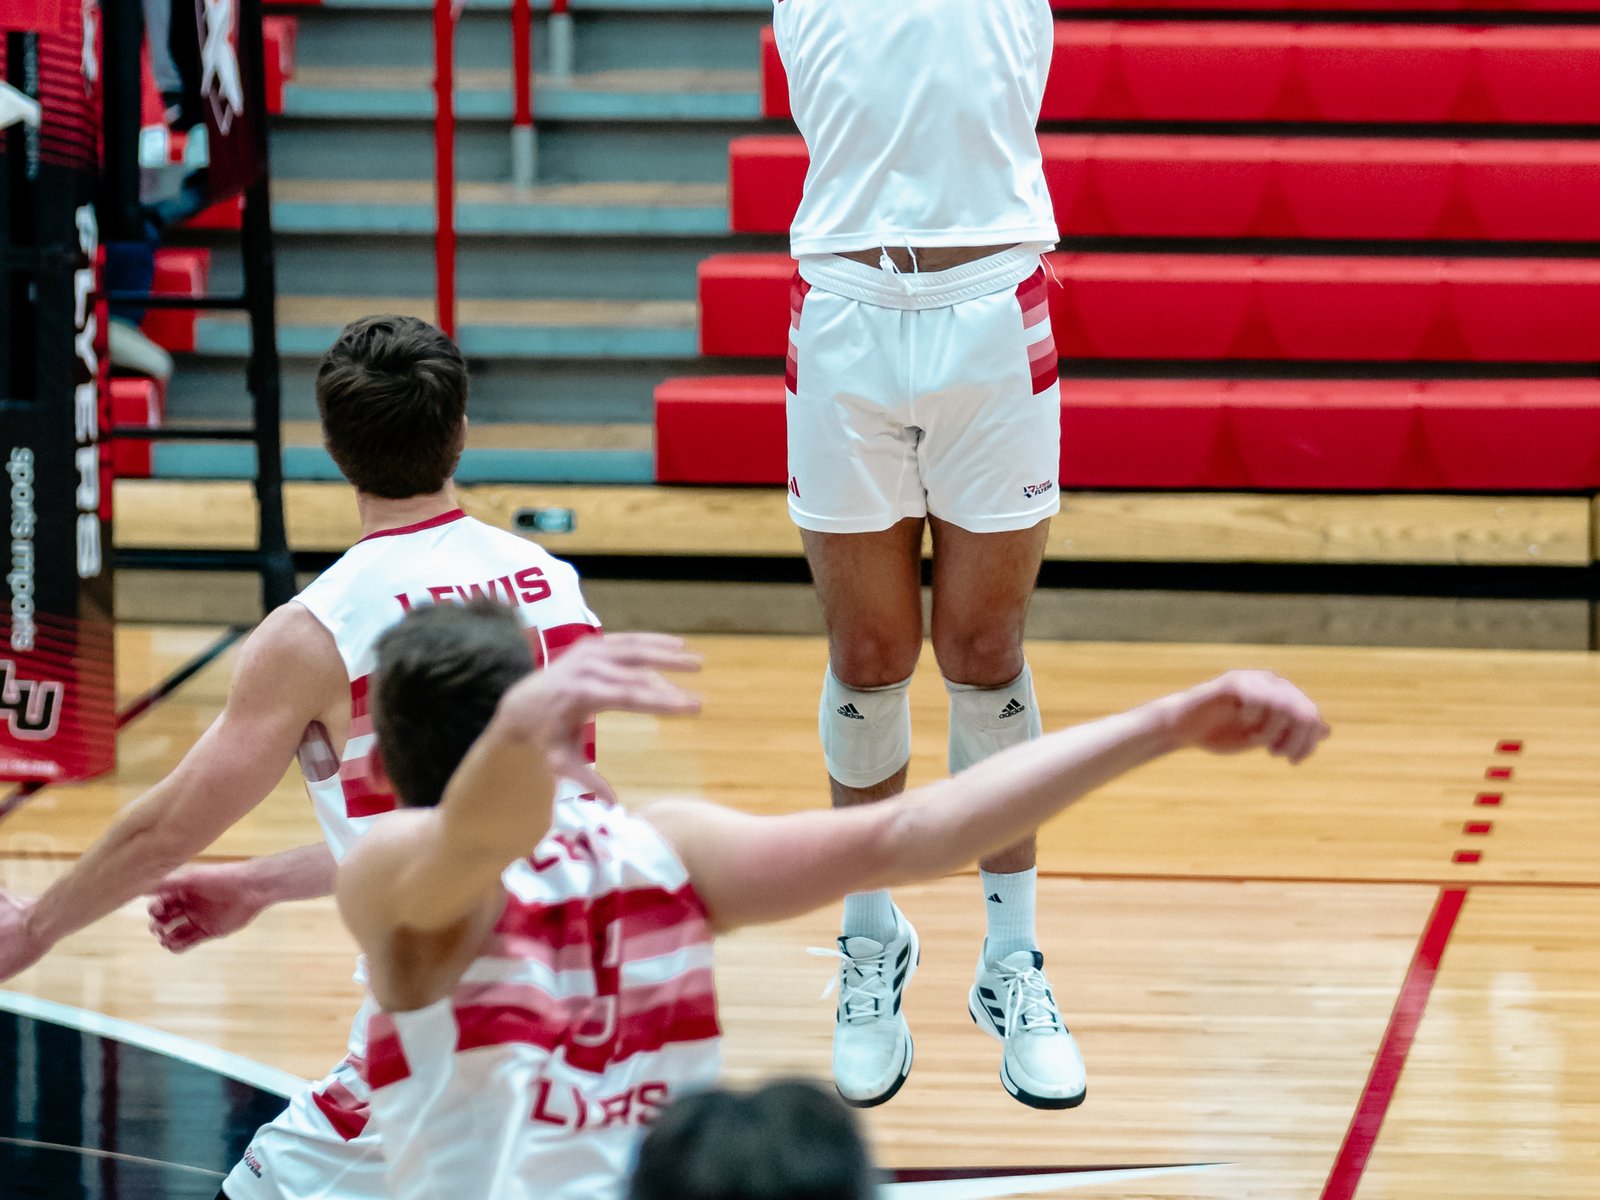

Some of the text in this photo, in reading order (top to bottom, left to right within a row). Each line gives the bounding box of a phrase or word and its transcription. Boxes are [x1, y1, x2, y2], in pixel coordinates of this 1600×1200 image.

[74, 202, 102, 579] FLYERS
[837, 708, 865, 720] adidas
[998, 705, 1025, 719] adidas
